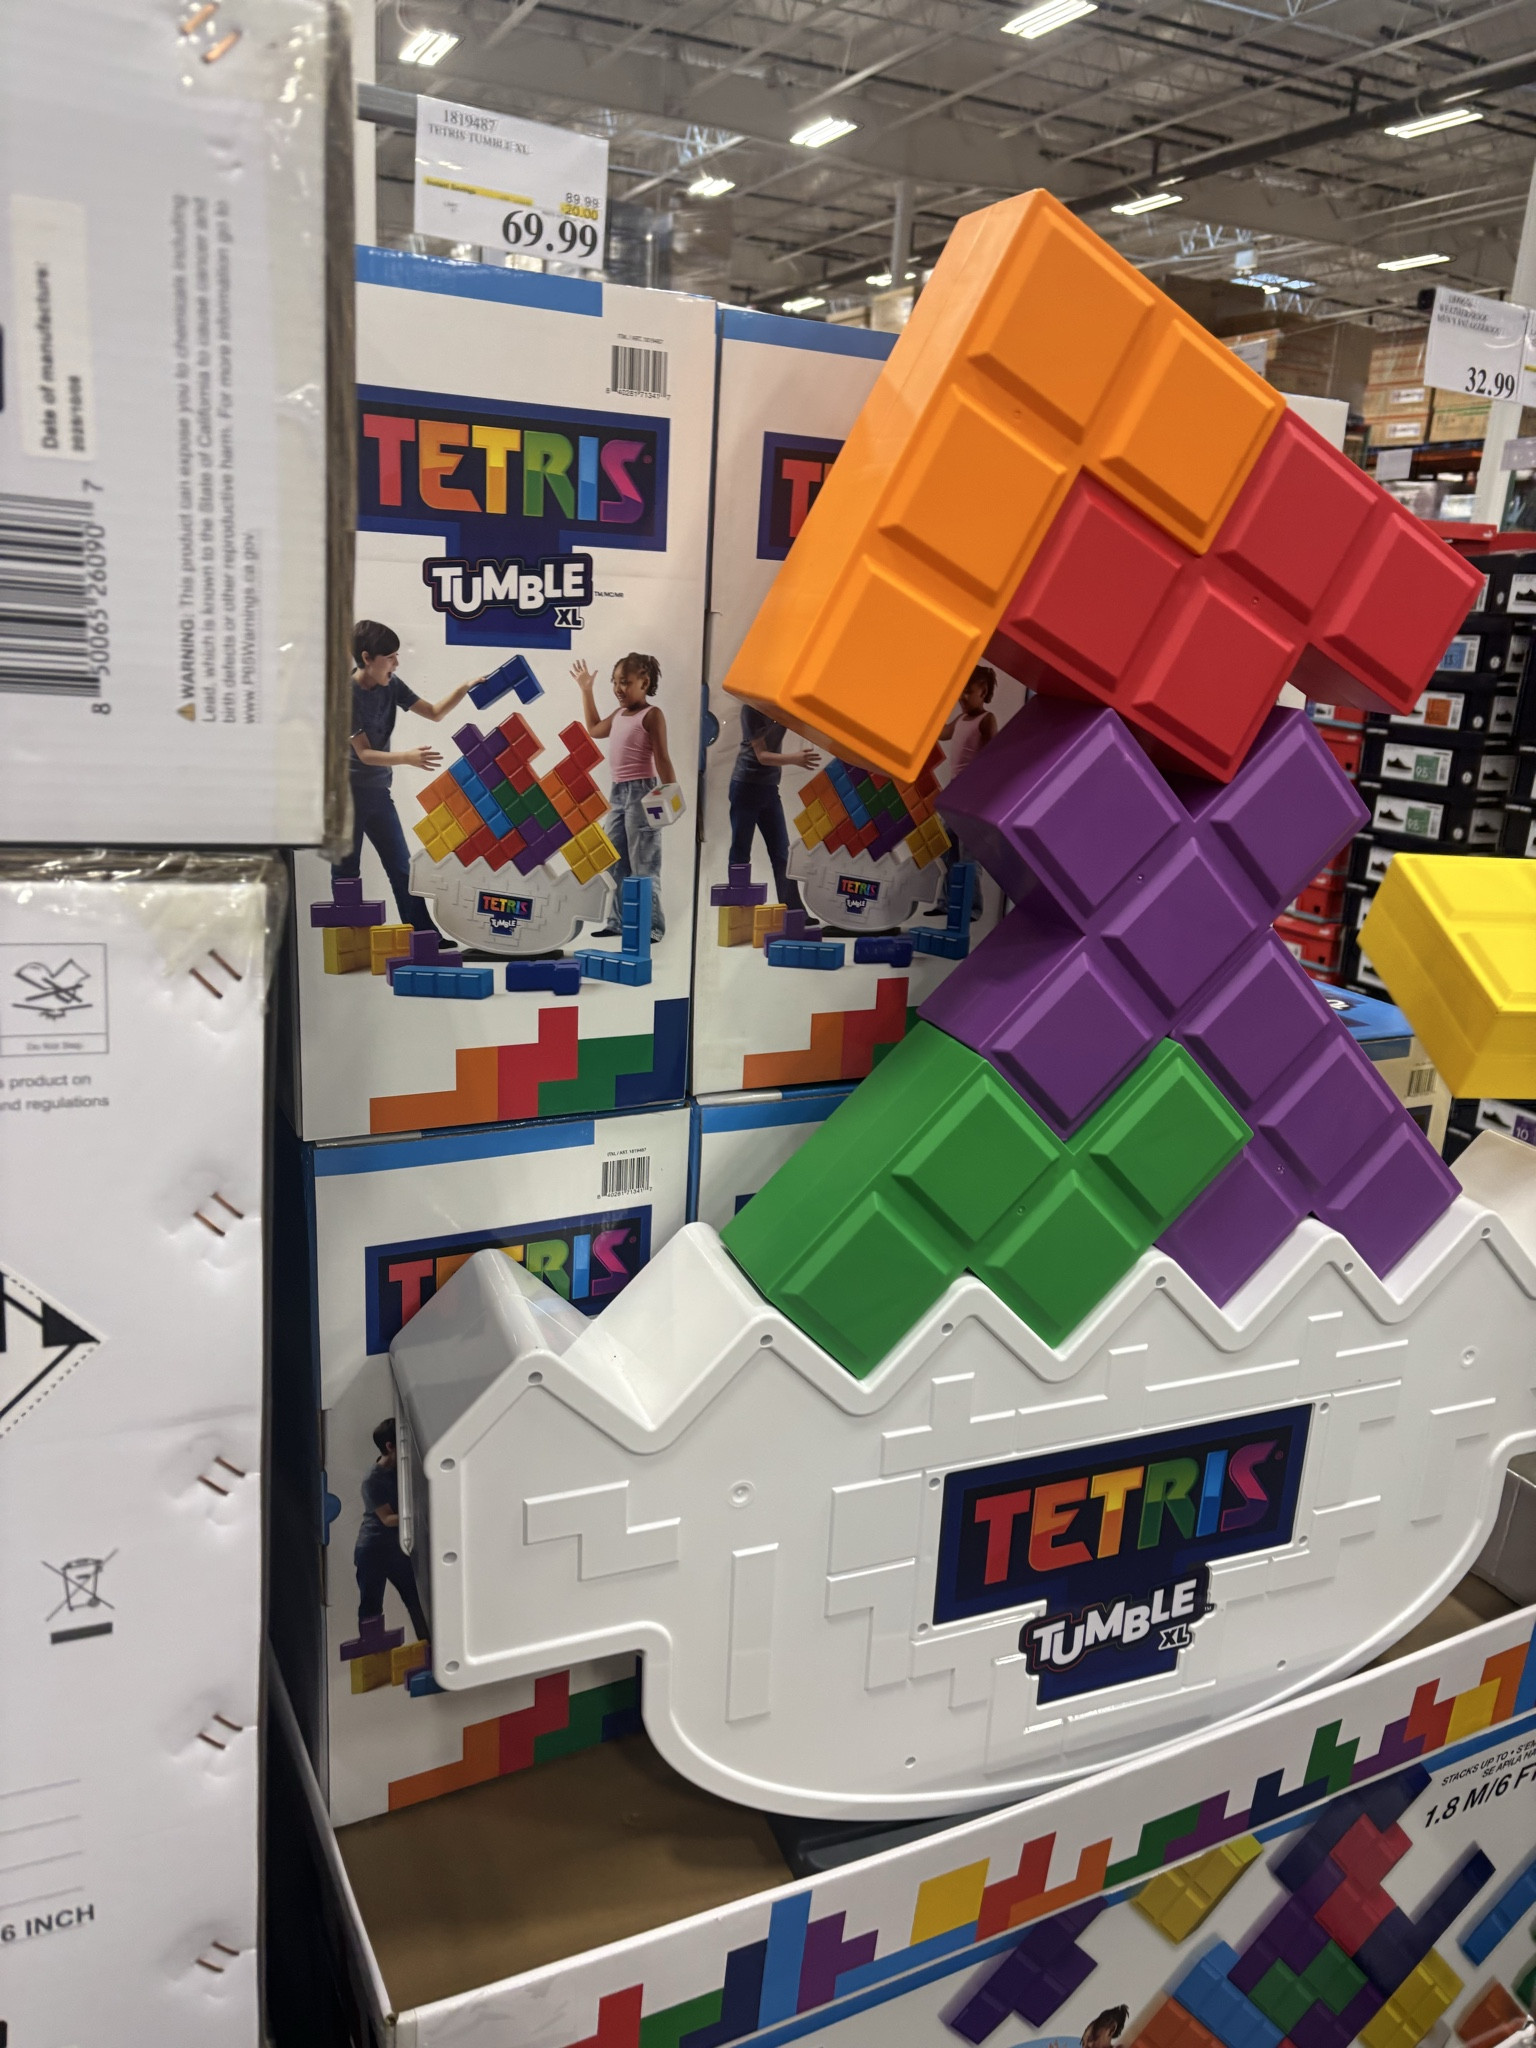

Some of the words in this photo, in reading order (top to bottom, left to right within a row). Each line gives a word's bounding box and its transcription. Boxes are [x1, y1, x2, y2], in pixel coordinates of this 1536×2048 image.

[444, 109, 497, 132] 1819487
[428, 123, 466, 142] TETRIS
[468, 132, 512, 152] TUMBLE
[502, 210, 598, 259] 69.99
[37, 385, 56, 405] of
[178, 383, 194, 412] you
[1465, 366, 1516, 399] 32.99
[40, 409, 59, 450] Date
[179, 418, 193, 477] expose
[363, 413, 648, 524] TETRIS
[82, 479, 103, 493] 7
[198, 517, 214, 543] the
[219, 473, 238, 569] reproductive
[177, 514, 197, 572] product
[200, 546, 214, 561] to
[85, 524, 107, 597] 26090
[179, 577, 194, 606] This
[200, 566, 215, 615] known
[221, 573, 236, 612] other
[432, 563, 585, 613] TUMBLE
[201, 619, 215, 631] is
[224, 616, 236, 631] or
[555, 606, 583, 629] XL
[88, 608, 110, 677] 50065
[180, 613, 195, 699] WARNING:
[201, 636, 215, 678] which
[221, 635, 237, 688] defects
[91, 703, 111, 715] 8
[222, 692, 237, 724] birth
[482, 895, 529, 915] TETRIS
[841, 879, 877, 898] TETRIS
[9, 1074, 68, 1090] product
[71, 1075, 91, 1086] on
[25, 1096, 110, 1113] regulations
[1516, 1126, 1529, 1141] 10
[388, 1228, 631, 1328] TRIS
[974, 1441, 1279, 1586] TETRIS
[1033, 1578, 1198, 1666] TUMBLE
[1158, 1623, 1190, 1650] XL
[1441, 1763, 1480, 1787] STACKS
[1481, 1756, 1495, 1769] UP
[1496, 1751, 1509, 1764] TO
[1482, 1766, 1497, 1778] SE
[1496, 1754, 1522, 1773] APILA
[1425, 1796, 1461, 1829] 1.8
[1462, 1773, 1513, 1813] M/6
[25, 1903, 95, 1937] INCH
